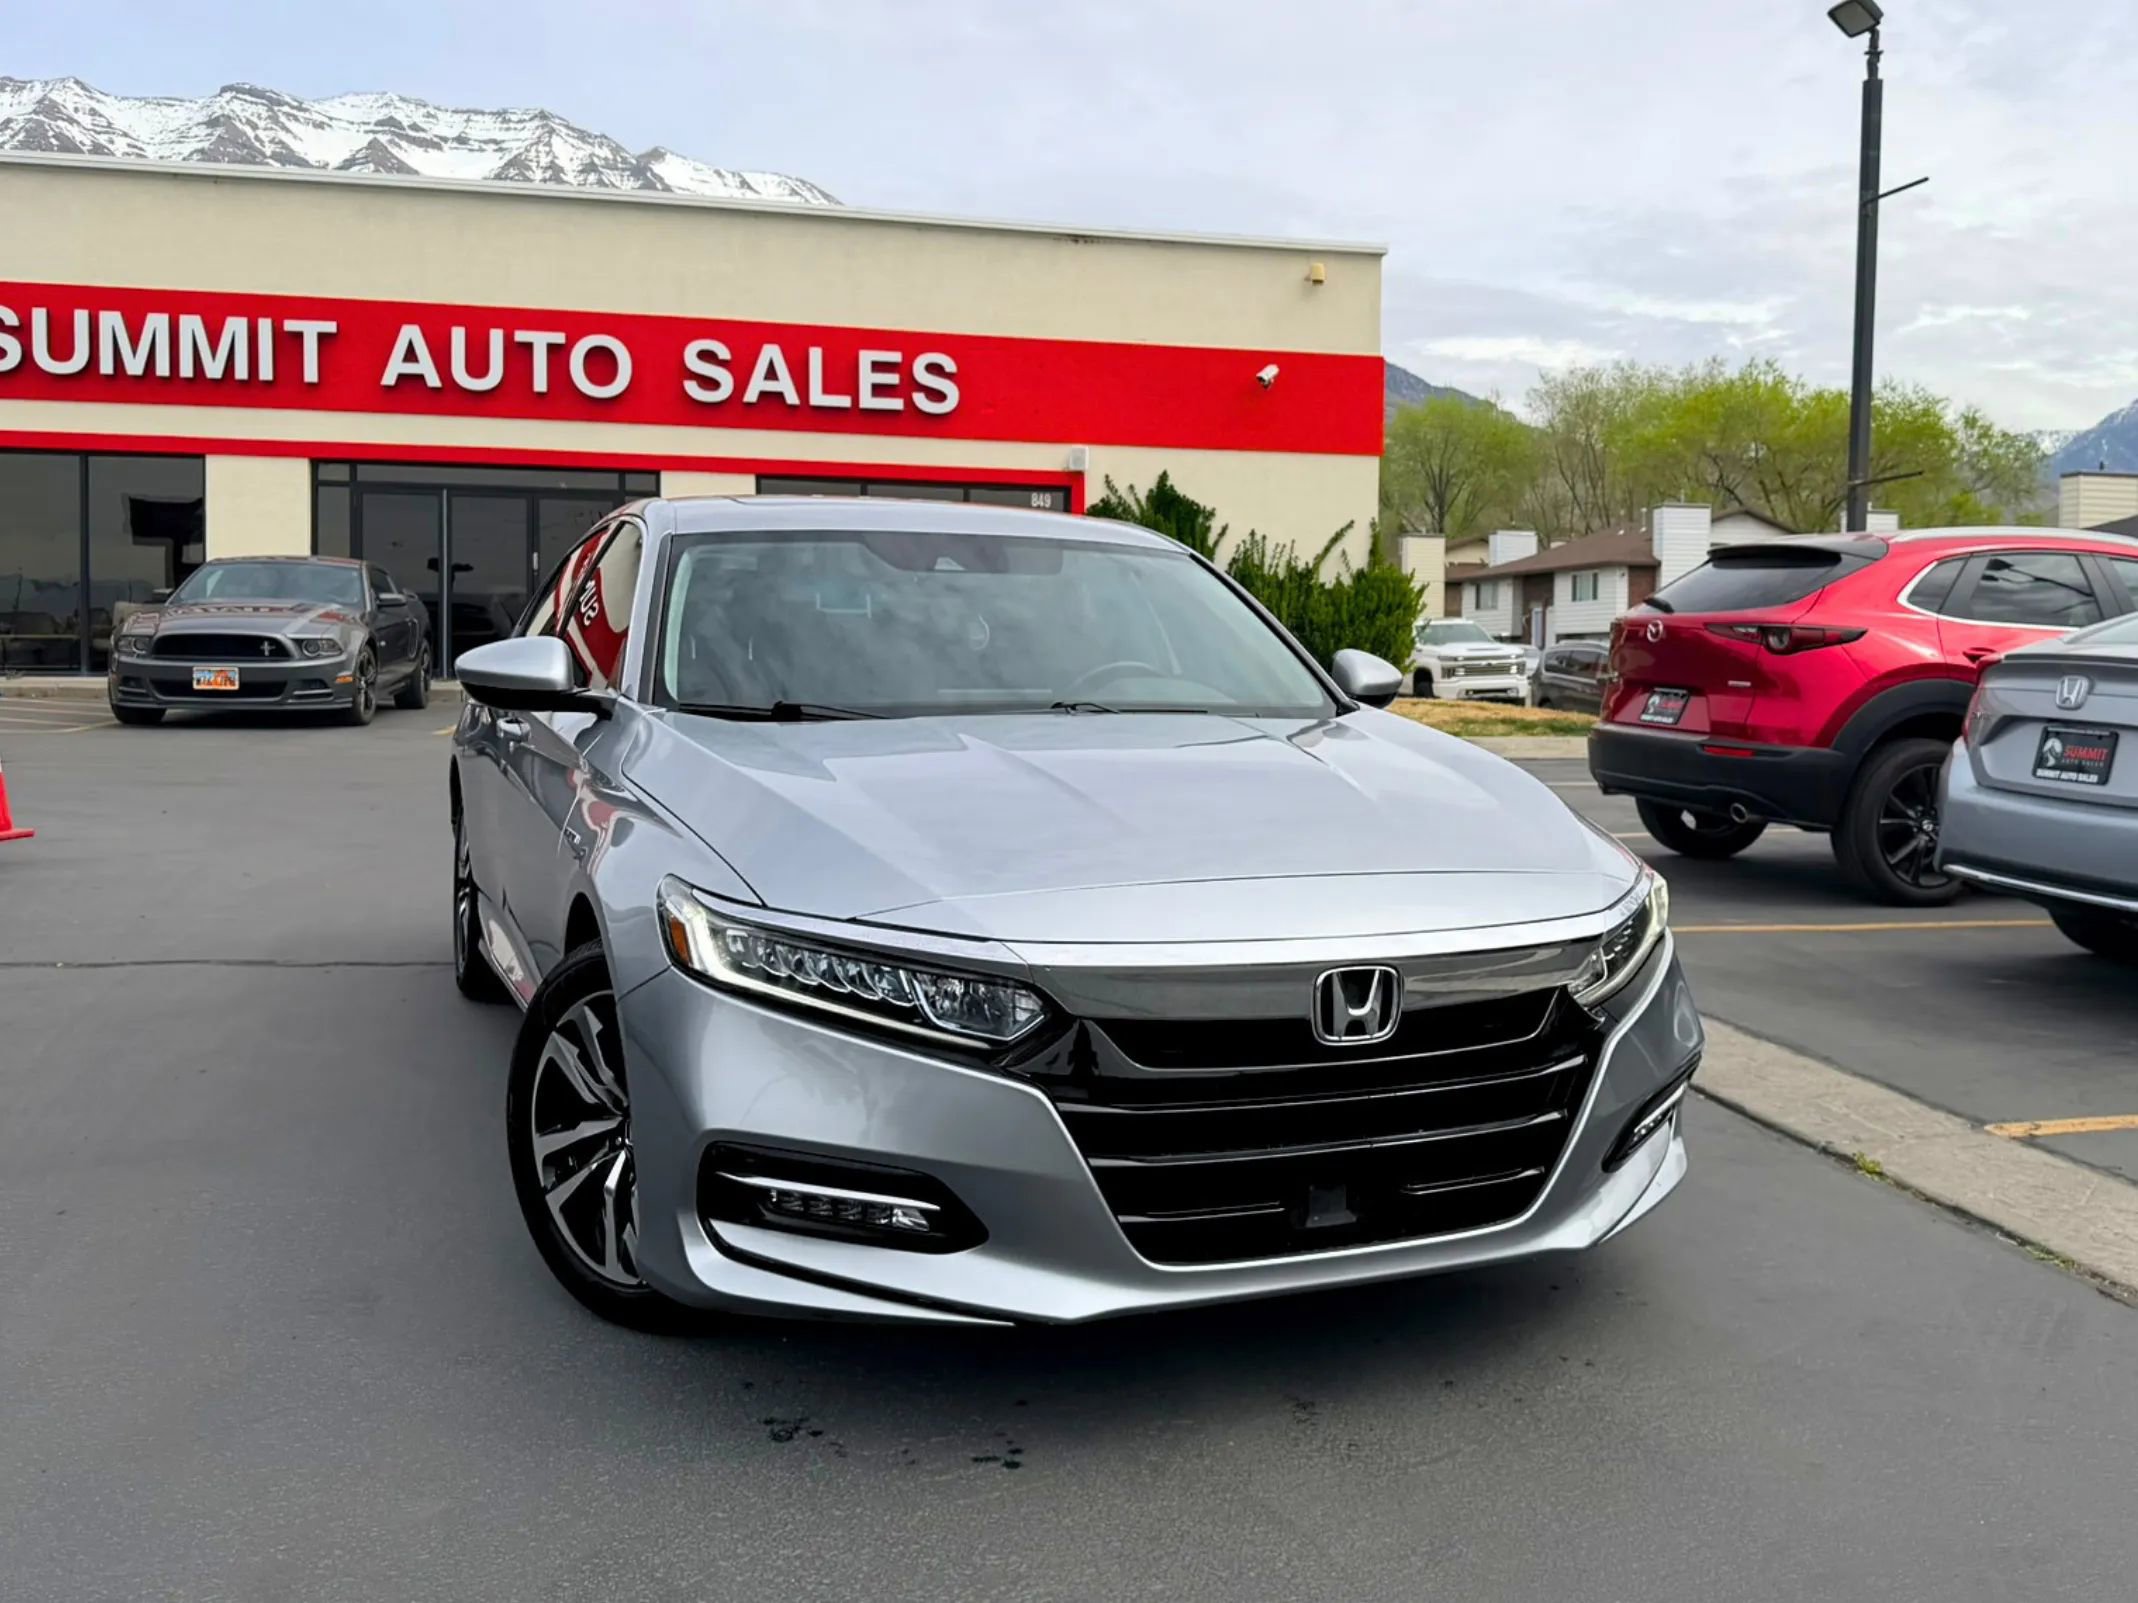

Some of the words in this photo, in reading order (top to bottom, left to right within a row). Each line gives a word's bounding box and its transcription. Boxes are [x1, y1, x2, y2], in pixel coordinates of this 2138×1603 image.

[380, 324, 632, 399] AUTO
[683, 339, 960, 414] SALES
[1031, 492, 1051, 508] 849
[2063, 744, 2109, 762] SUMMIT
[2060, 770, 2078, 781] AUTO
[2078, 772, 2099, 783] SALES
